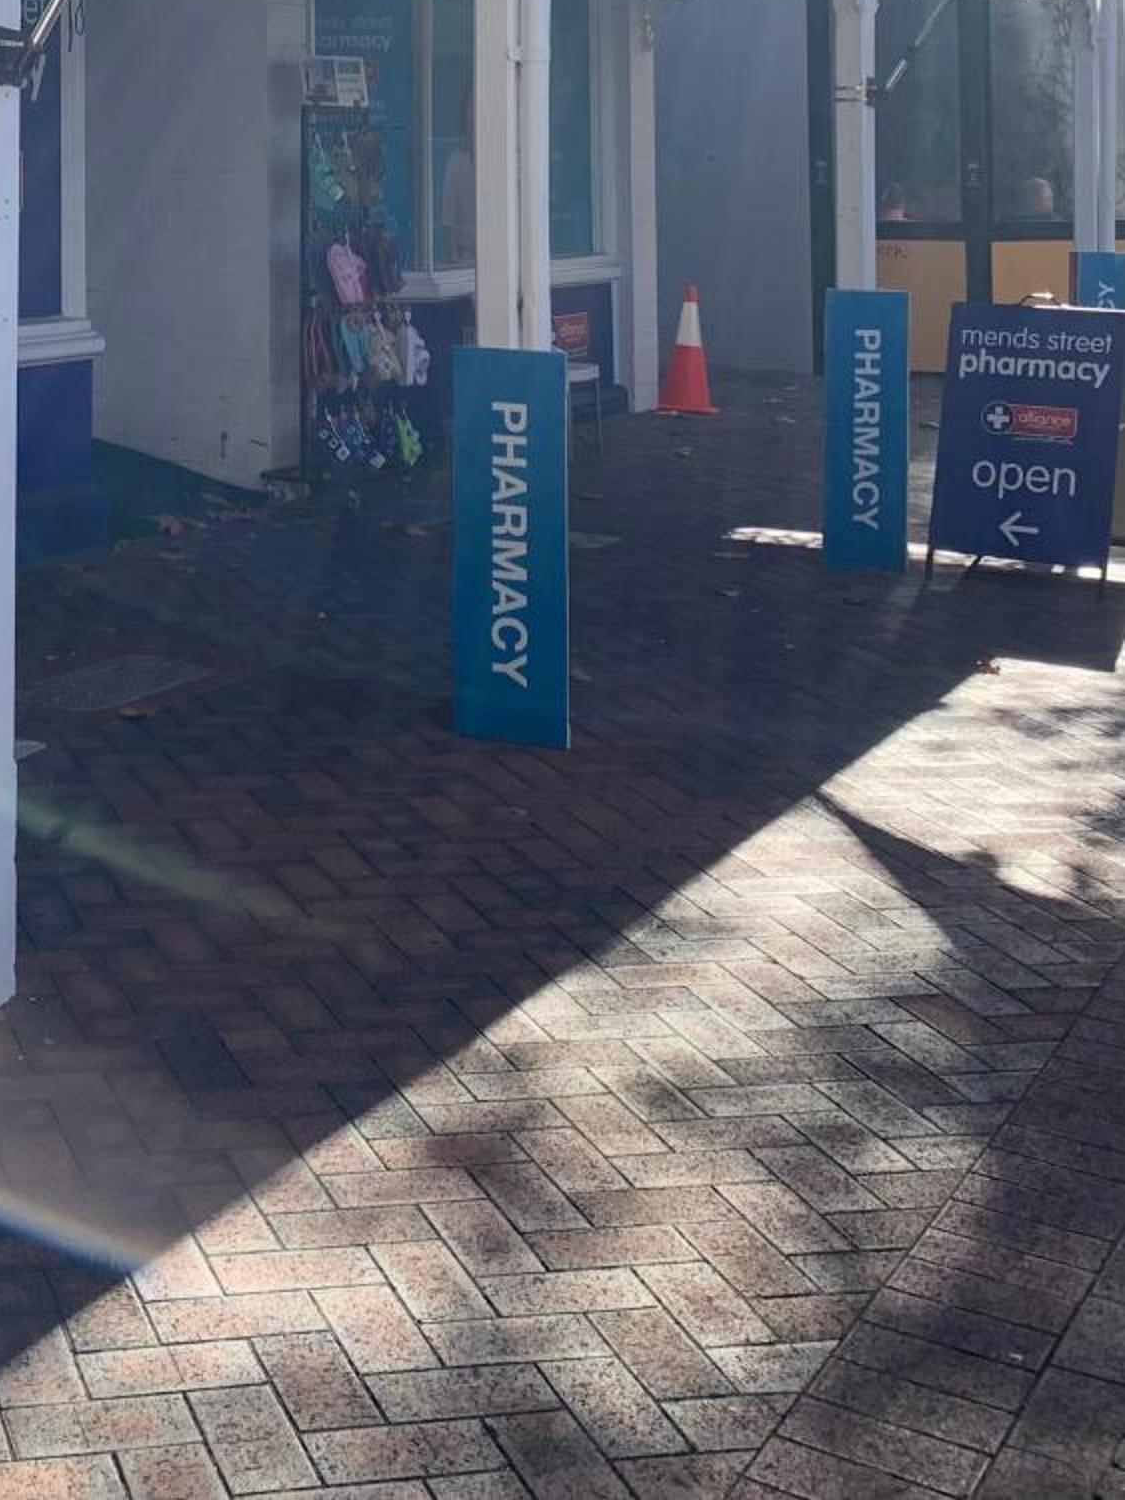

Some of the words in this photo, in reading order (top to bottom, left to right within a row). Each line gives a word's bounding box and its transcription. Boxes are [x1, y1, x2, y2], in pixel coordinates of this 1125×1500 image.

[962, 327, 1040, 349] mends
[1046, 331, 1113, 354] street
[959, 348, 1111, 389] pharmacy
[851, 328, 882, 531] PHARMACY
[972, 460, 1077, 500] open
[491, 400, 529, 689] PHARMACY
